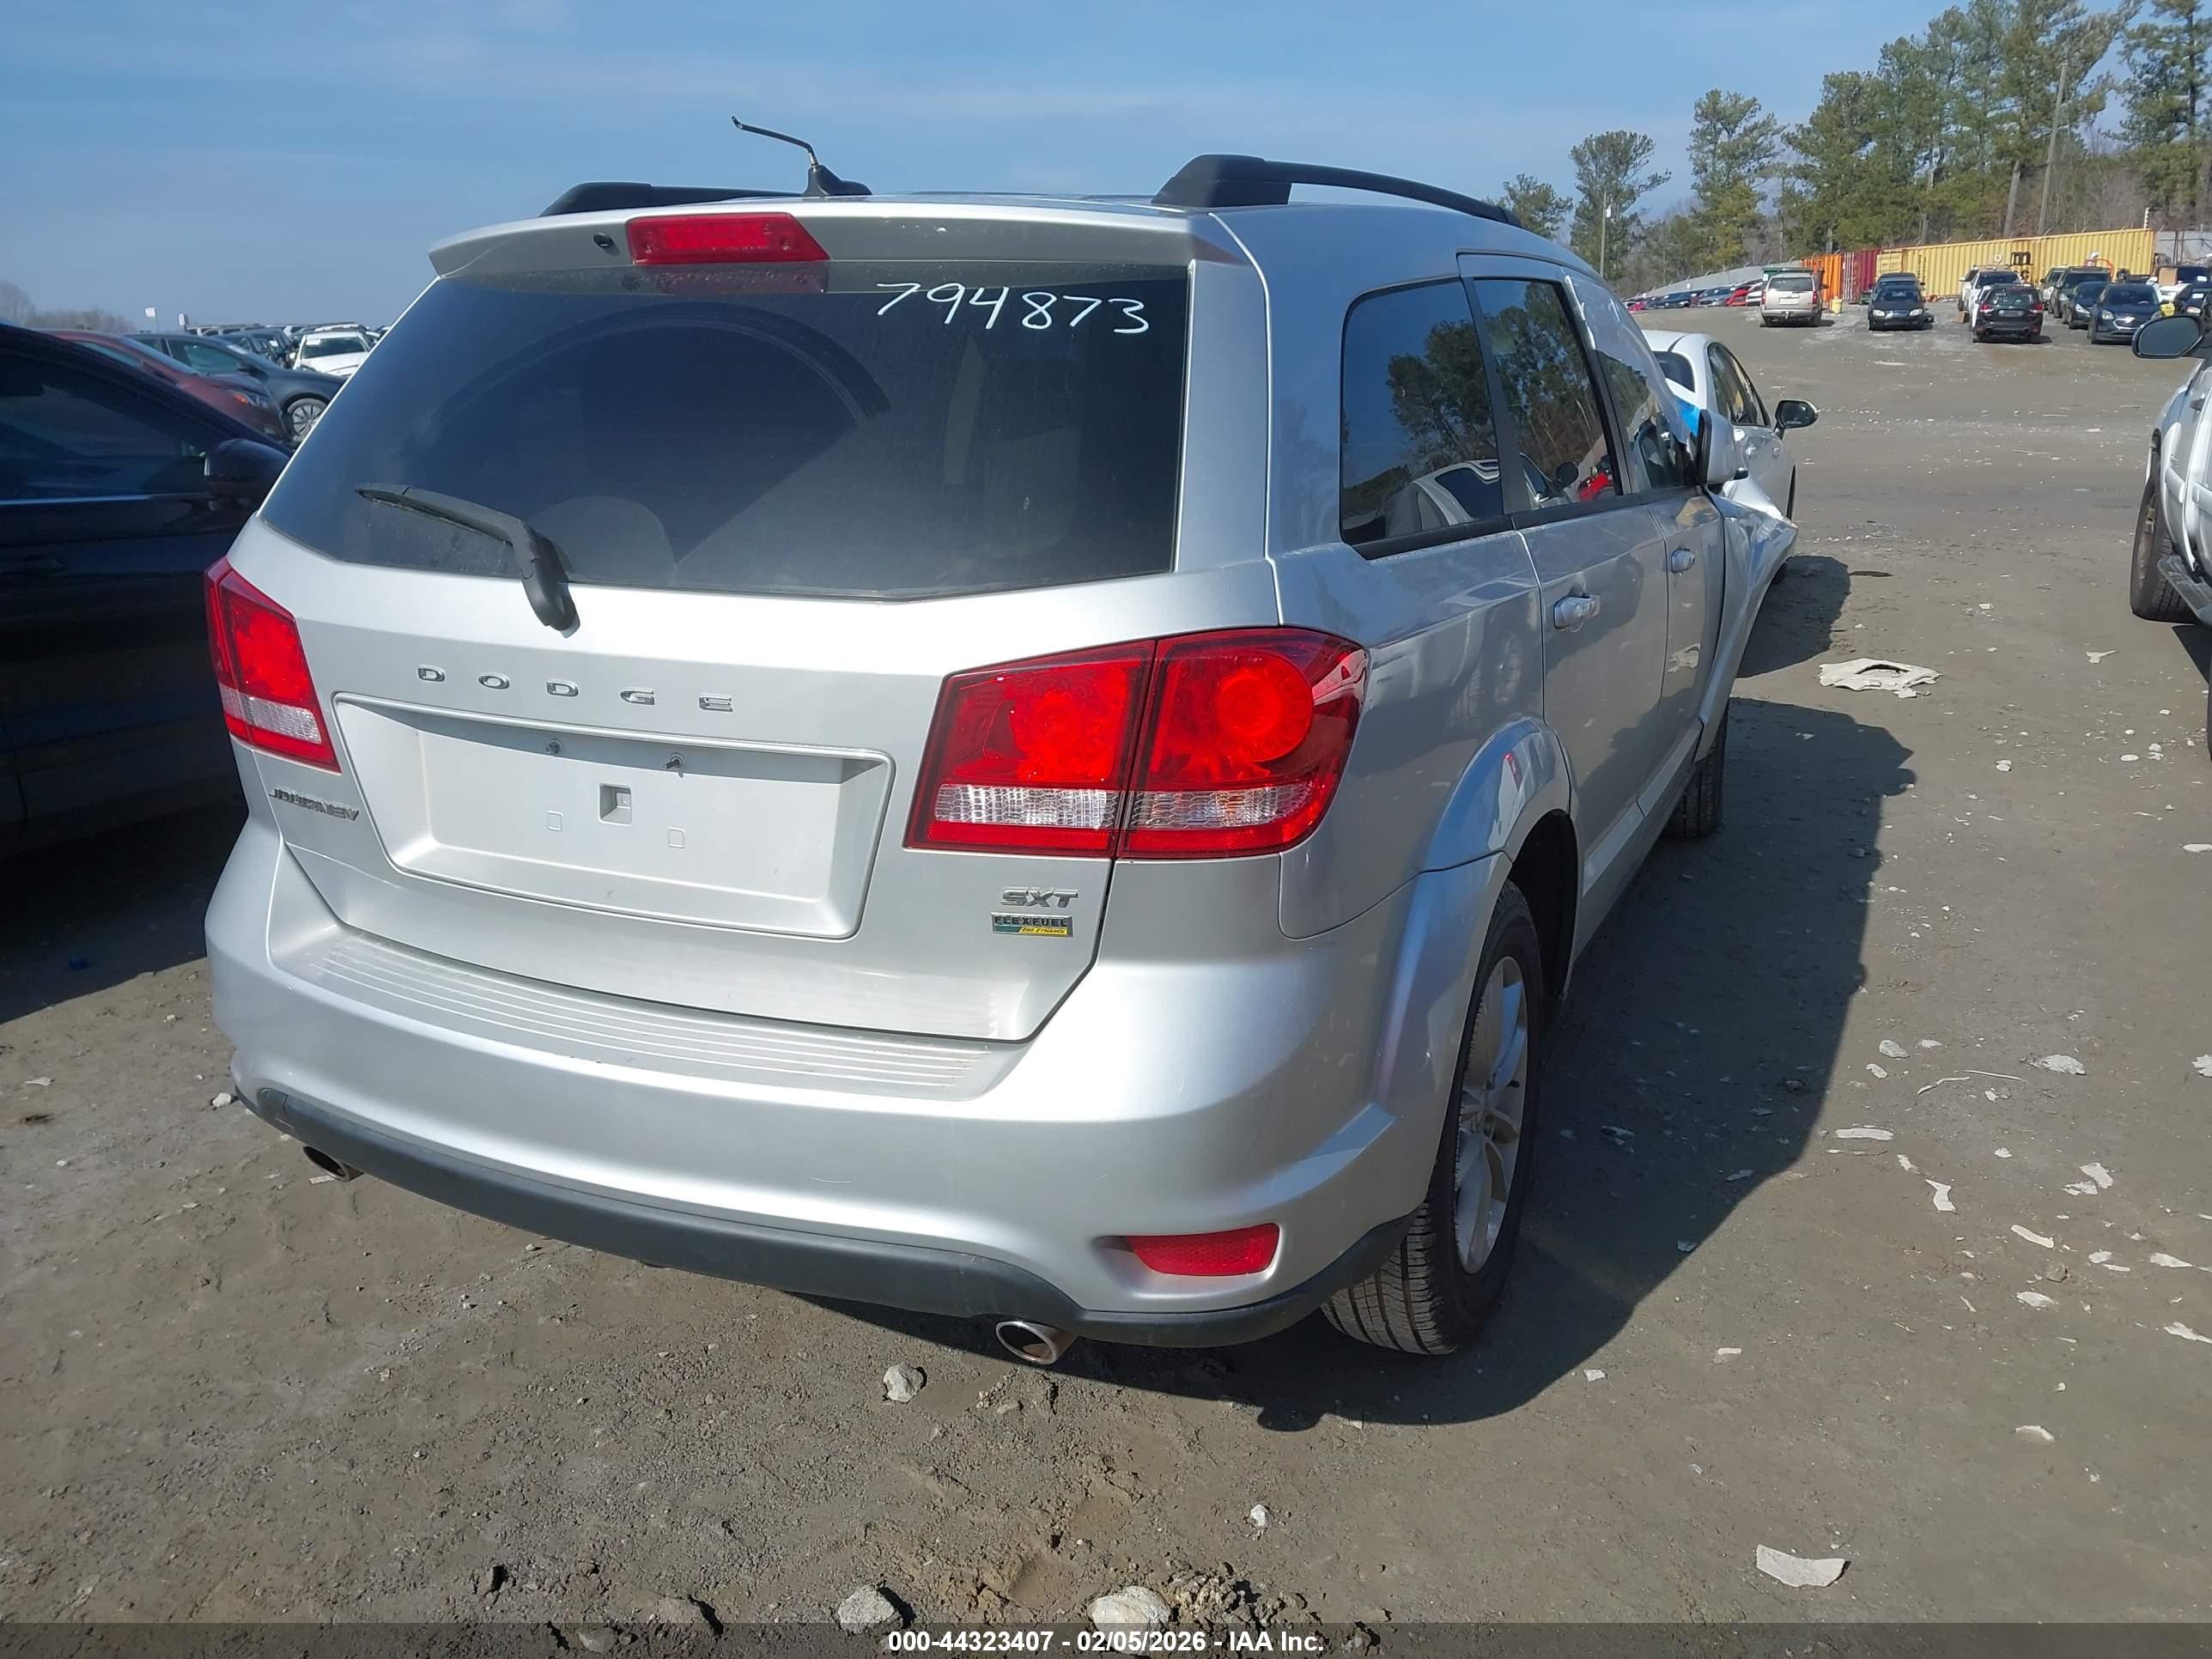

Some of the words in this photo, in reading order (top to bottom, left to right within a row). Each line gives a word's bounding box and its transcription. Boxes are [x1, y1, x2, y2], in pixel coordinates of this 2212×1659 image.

[876, 283, 1149, 333] 794873
[417, 664, 733, 712] DODGE
[268, 787, 360, 822] JOURNEY
[1000, 888, 1079, 908] SXT
